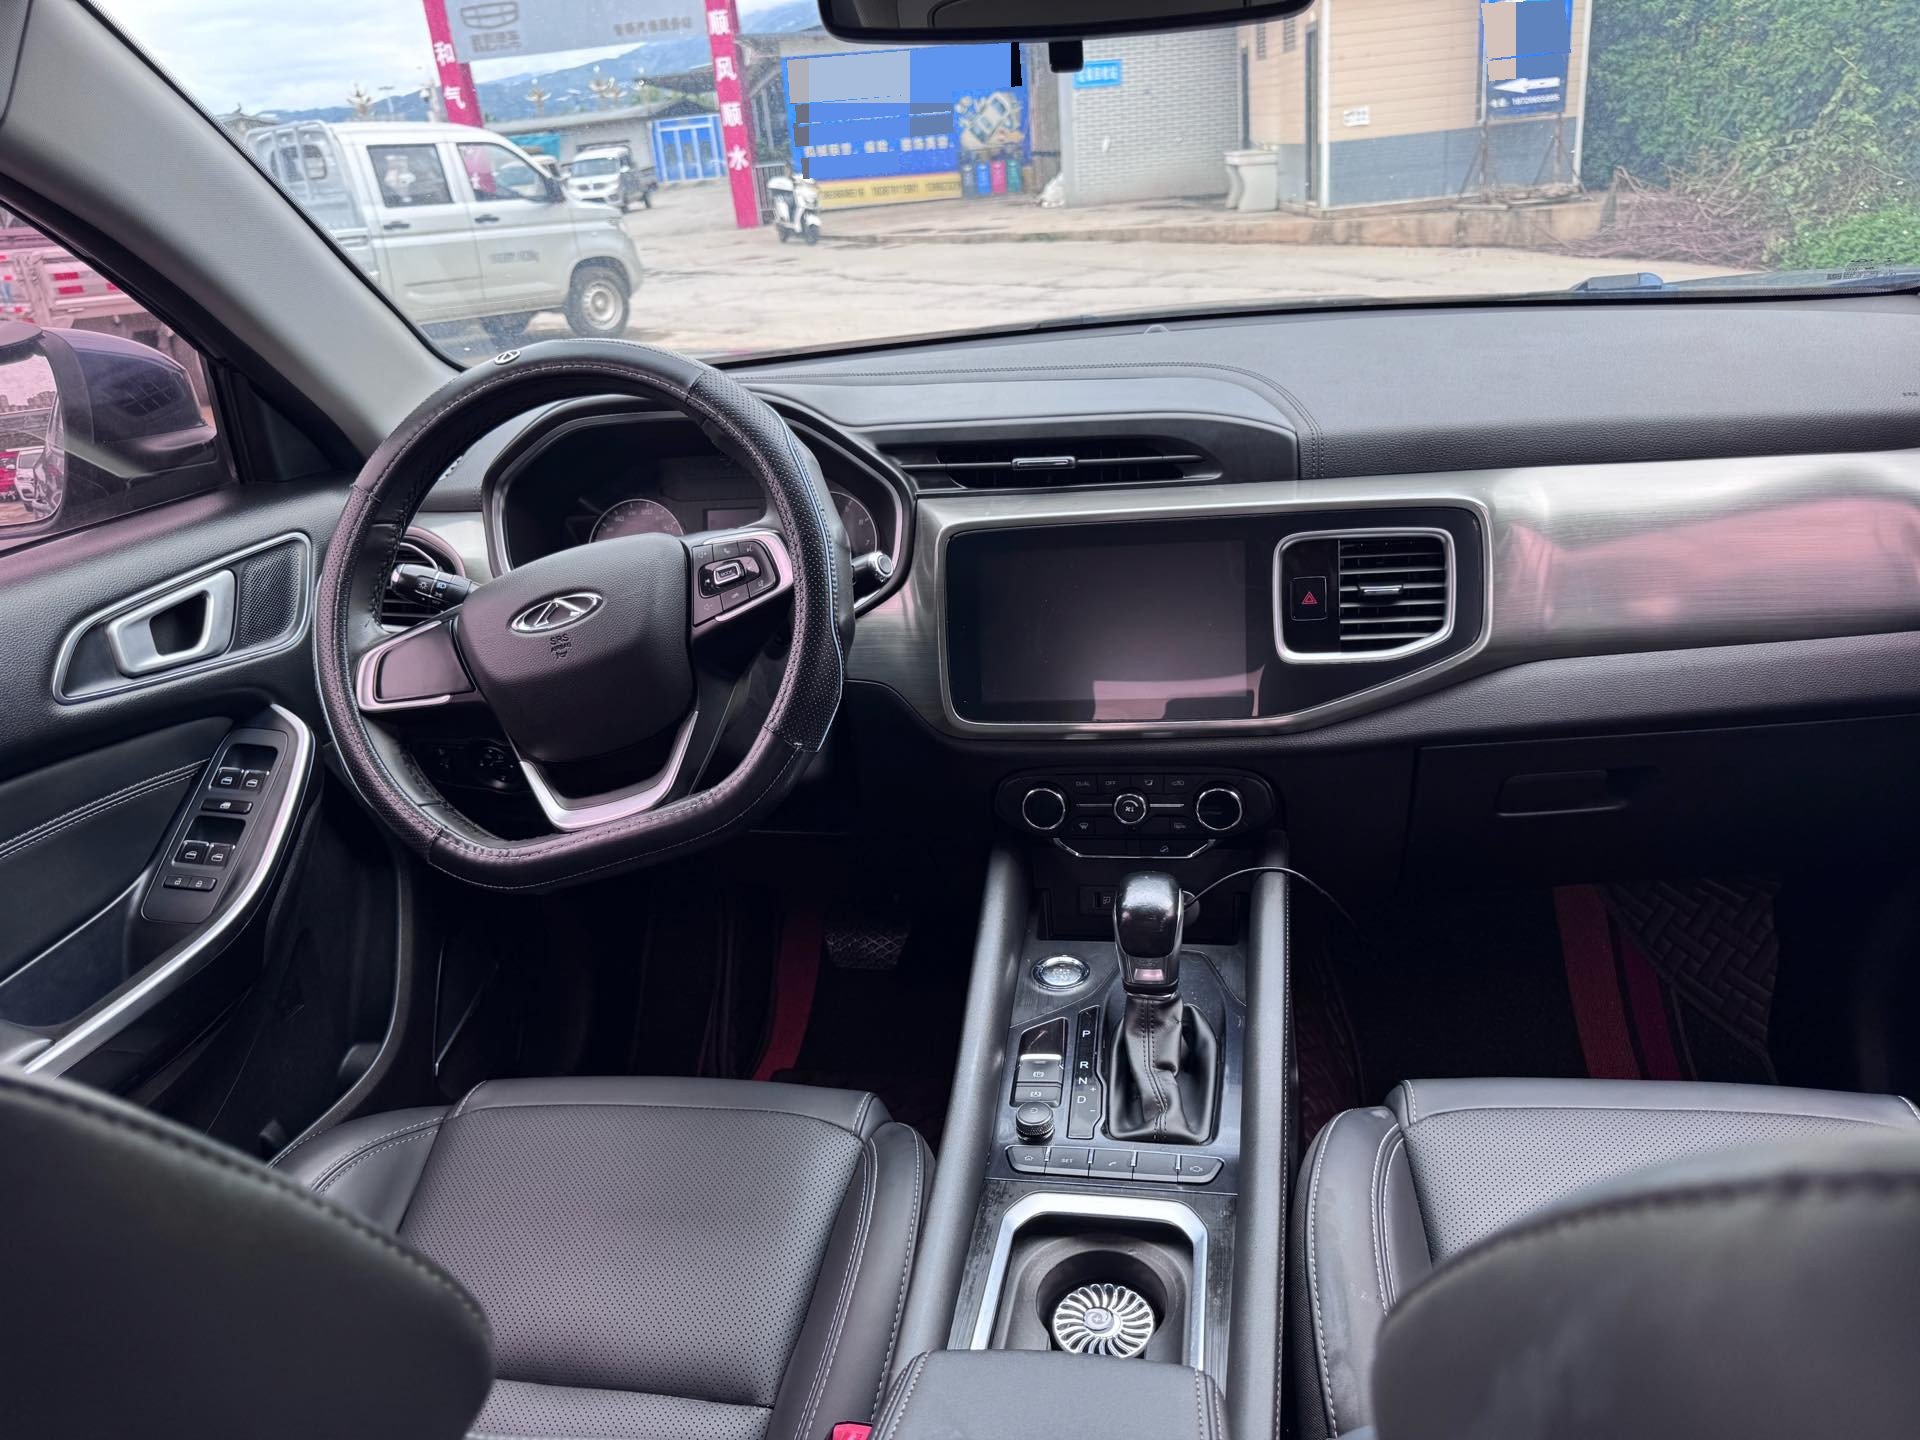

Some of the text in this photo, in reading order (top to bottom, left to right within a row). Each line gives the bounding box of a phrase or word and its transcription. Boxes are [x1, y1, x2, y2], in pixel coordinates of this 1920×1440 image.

[707, 9, 749, 171] 顺风顺水
[550, 633, 570, 645] SRS
[1082, 1029, 1091, 1038] P
[1079, 1061, 1089, 1069] R
[1078, 1077, 1088, 1085] N
[1077, 1095, 1087, 1104] D
